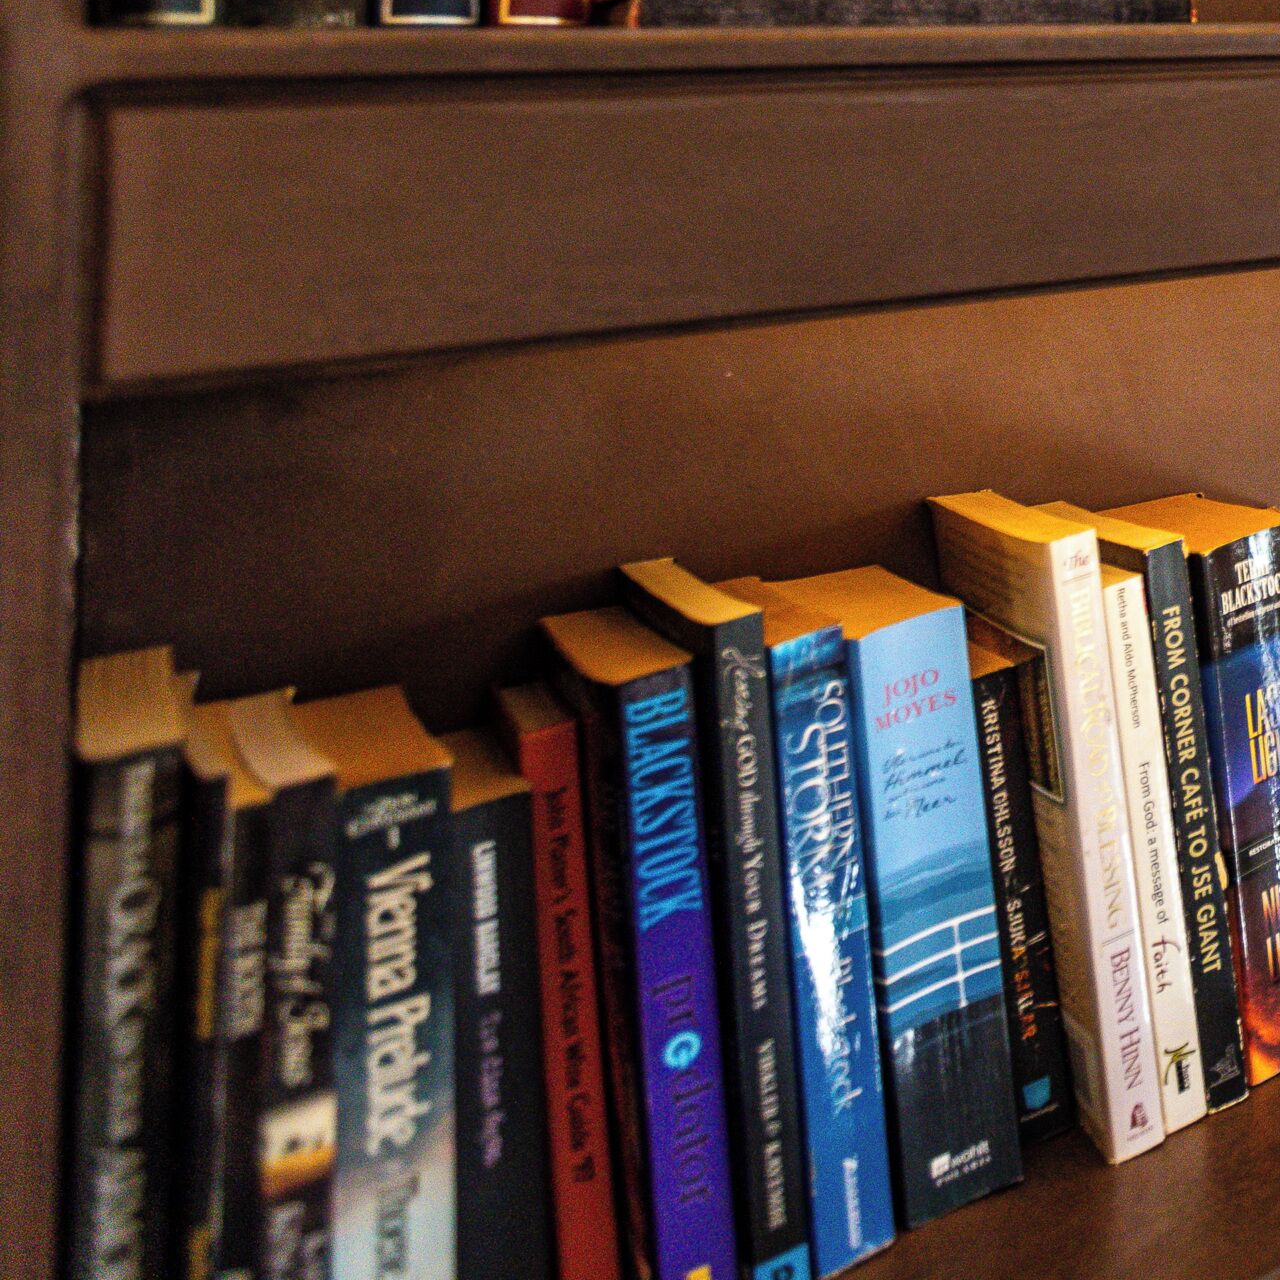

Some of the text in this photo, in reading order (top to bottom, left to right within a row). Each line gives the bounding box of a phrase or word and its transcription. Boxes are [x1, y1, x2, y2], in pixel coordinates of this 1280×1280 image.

[1062, 549, 1090, 571] The
[882, 667, 940, 709] JOJO
[1117, 587, 1142, 729] Retha and Aldo McPherson
[873, 687, 959, 734] MOYES
[812, 678, 861, 877] SOUTHERN
[980, 698, 1015, 876] KRISTINA OHLSSON
[1068, 585, 1100, 704] BIBLICAL
[1096, 803, 1127, 931] BLESSING
[1138, 760, 1151, 799] From
[1162, 603, 1222, 974] FROM CORNER CAFÉ TO JSE GIANT
[624, 686, 705, 936] BLACKSTOCK
[719, 646, 770, 1012] Hearing GOD through YOUR DREAMS
[1143, 800, 1157, 832] God:
[1149, 851, 1167, 909] message
[365, 850, 435, 1004] Vienna
[553, 907, 577, 963] South
[1005, 898, 1029, 967] SJUKA
[1156, 908, 1170, 926] of
[1150, 936, 1182, 995] faith
[558, 966, 583, 1041] African
[1109, 946, 1143, 1093] BENNY HINN
[364, 991, 434, 1158] Prelude
[564, 1039, 587, 1091] Wine
